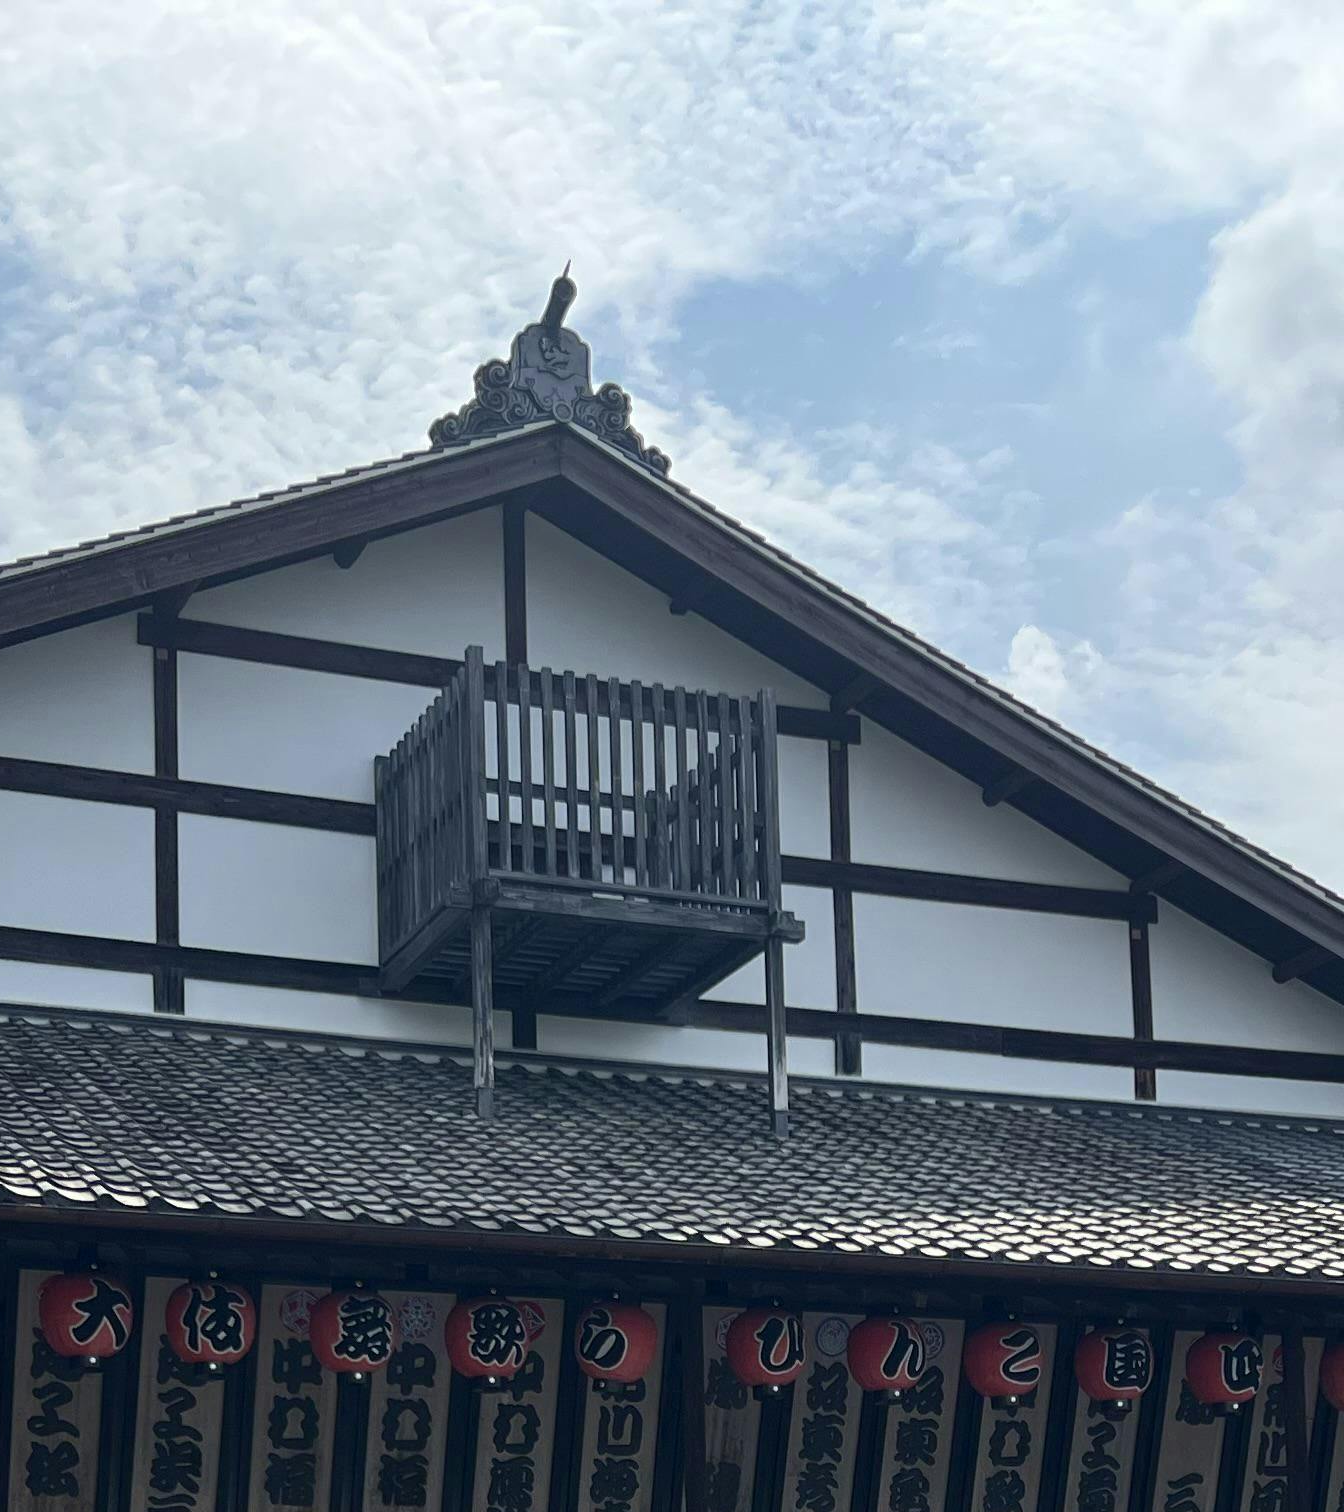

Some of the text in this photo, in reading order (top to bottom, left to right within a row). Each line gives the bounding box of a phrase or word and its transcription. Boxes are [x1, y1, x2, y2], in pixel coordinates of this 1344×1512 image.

[69, 1277, 132, 1350] 大
[180, 1284, 246, 1355] 伎
[332, 1296, 394, 1363] 舞
[467, 1303, 526, 1366] 歌
[881, 1321, 926, 1381] ん
[1000, 1330, 1041, 1384] こ
[1102, 1333, 1154, 1394] 国
[1218, 1339, 1264, 1394] 四
